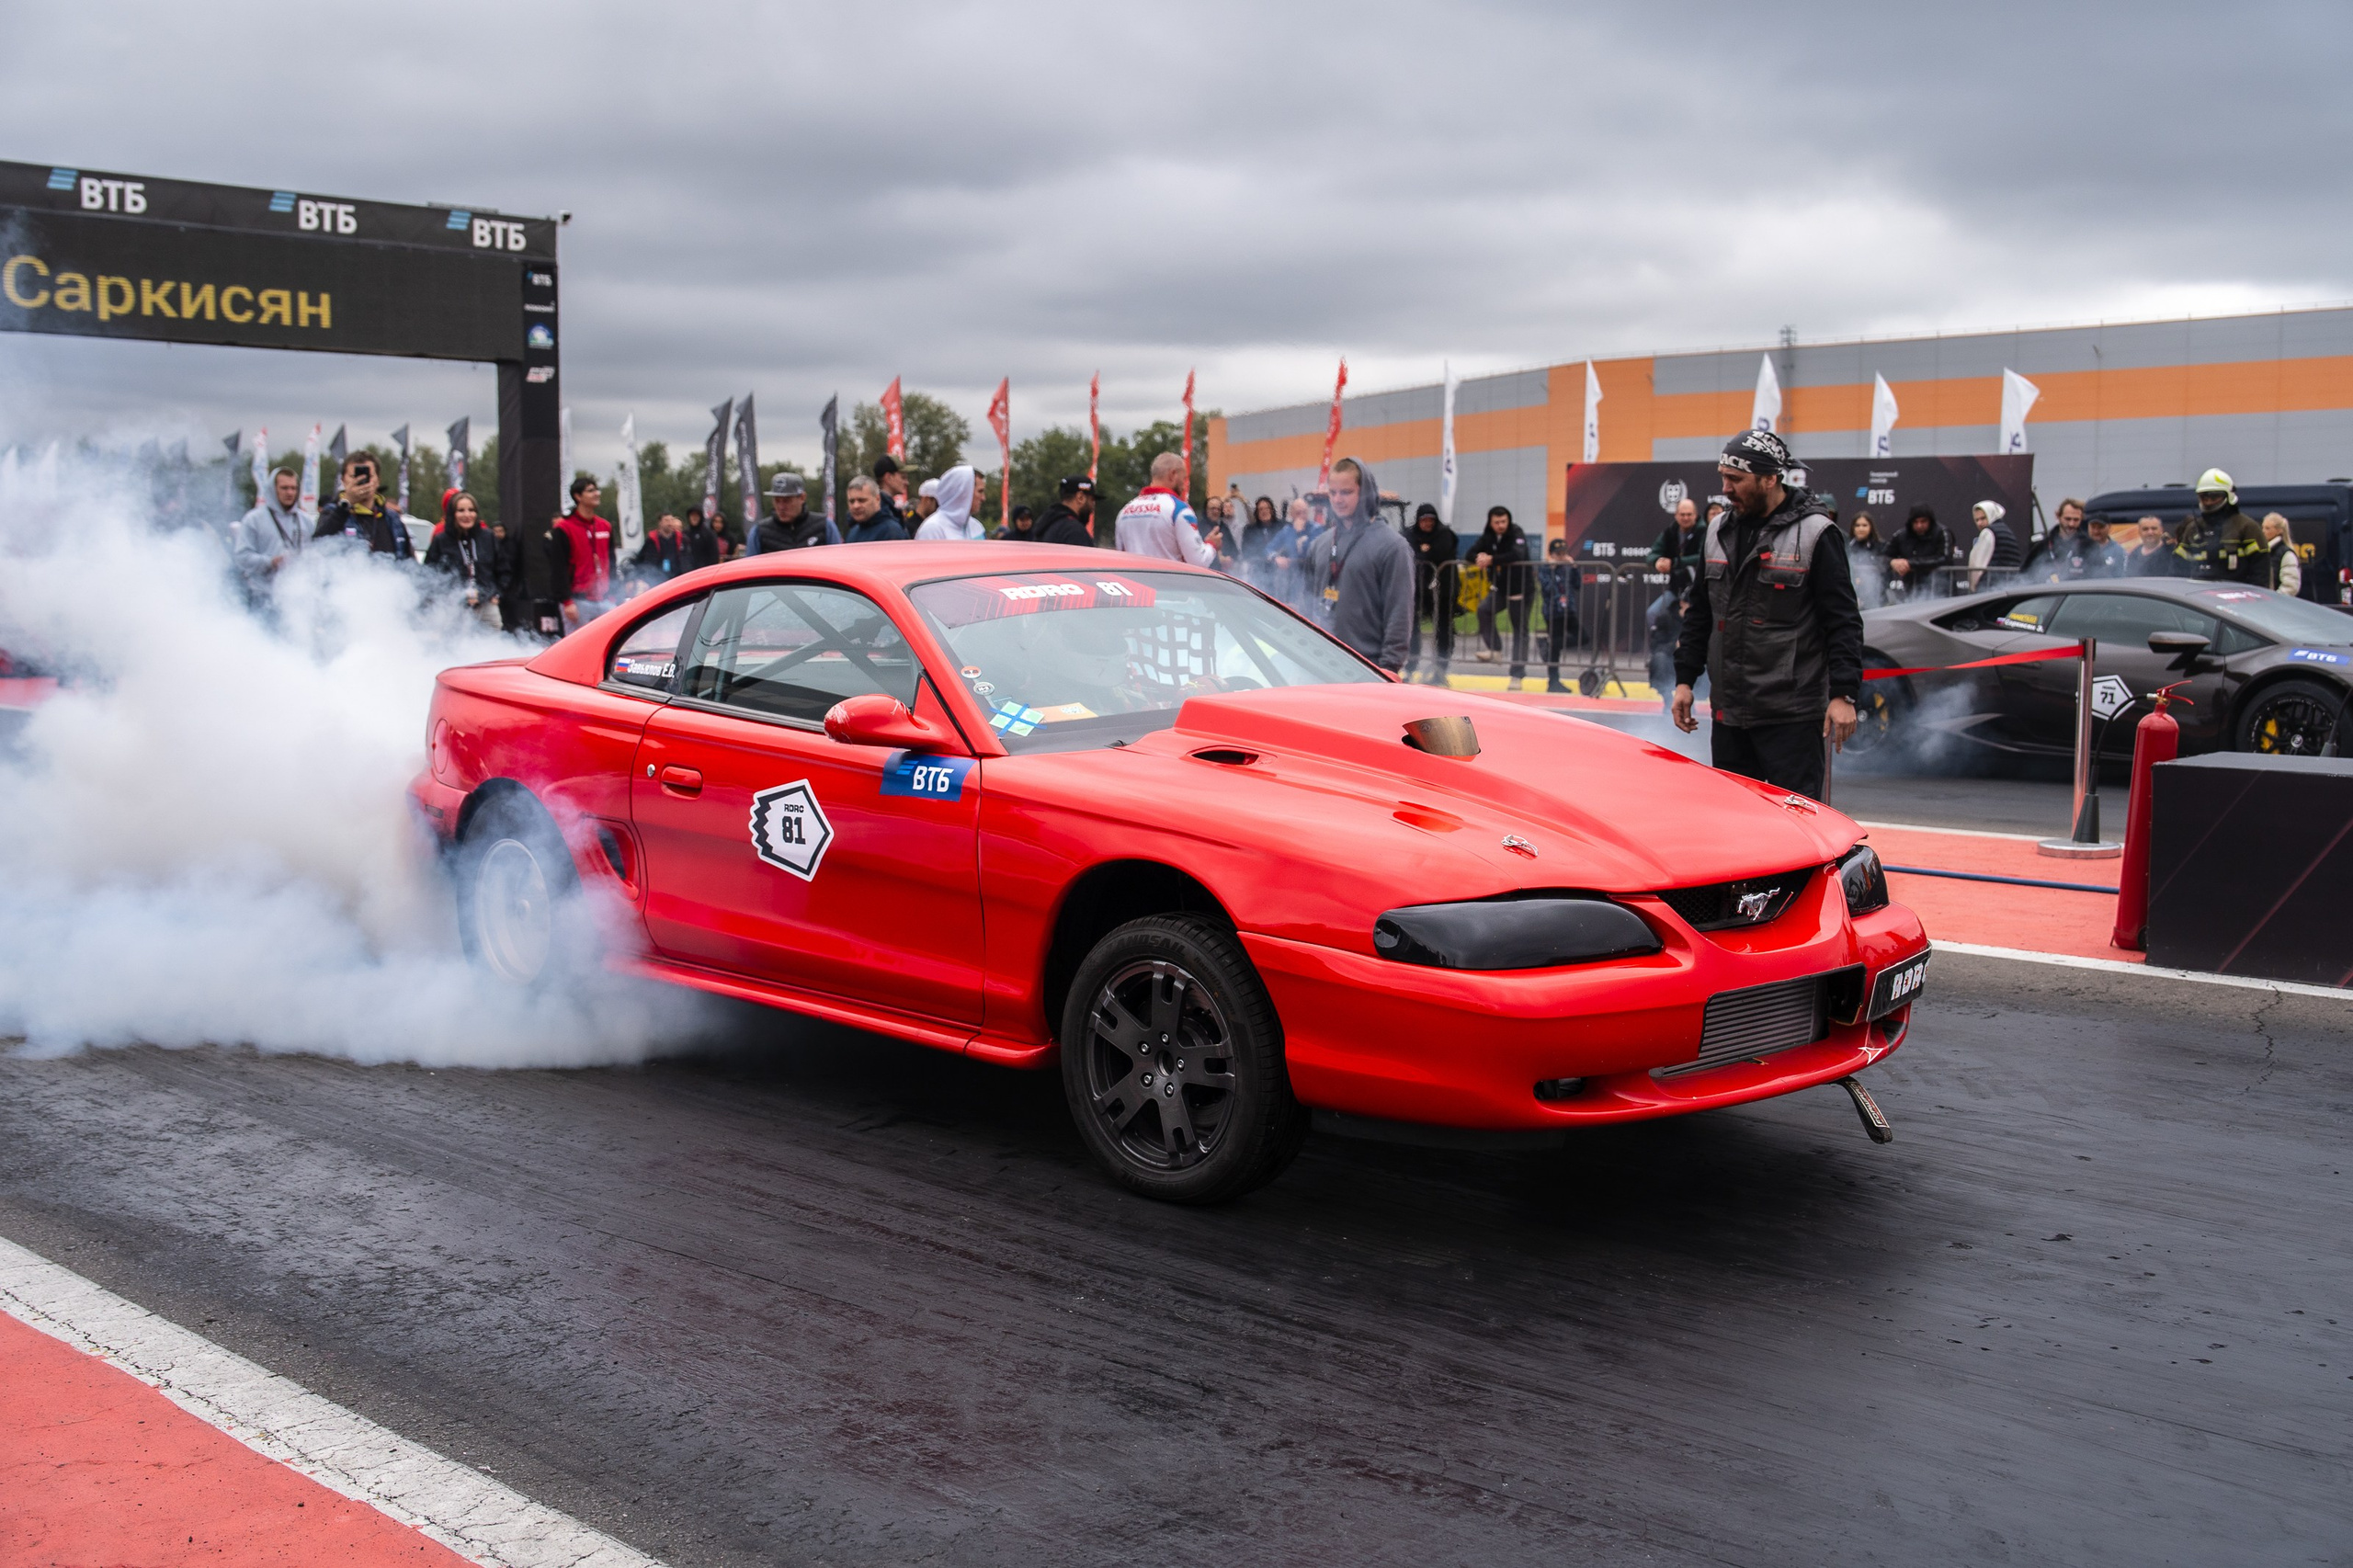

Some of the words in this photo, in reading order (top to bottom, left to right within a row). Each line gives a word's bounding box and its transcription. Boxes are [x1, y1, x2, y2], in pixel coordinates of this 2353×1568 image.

[80, 176, 147, 214] ВТБ
[298, 199, 358, 234] ВТБ
[472, 218, 527, 251] ВТБ
[2, 254, 332, 329] Саркисян
[1867, 488, 1895, 505] ВТБ
[1592, 542, 1616, 557] ВТБ
[1096, 581, 1133, 597] 81
[2306, 652, 2338, 663] ВТБ
[627, 659, 662, 676] Завьялов
[2100, 691, 2116, 705] 71
[912, 765, 955, 793] ВТБ
[783, 803, 805, 814] RDRC
[781, 815, 807, 846] 81
